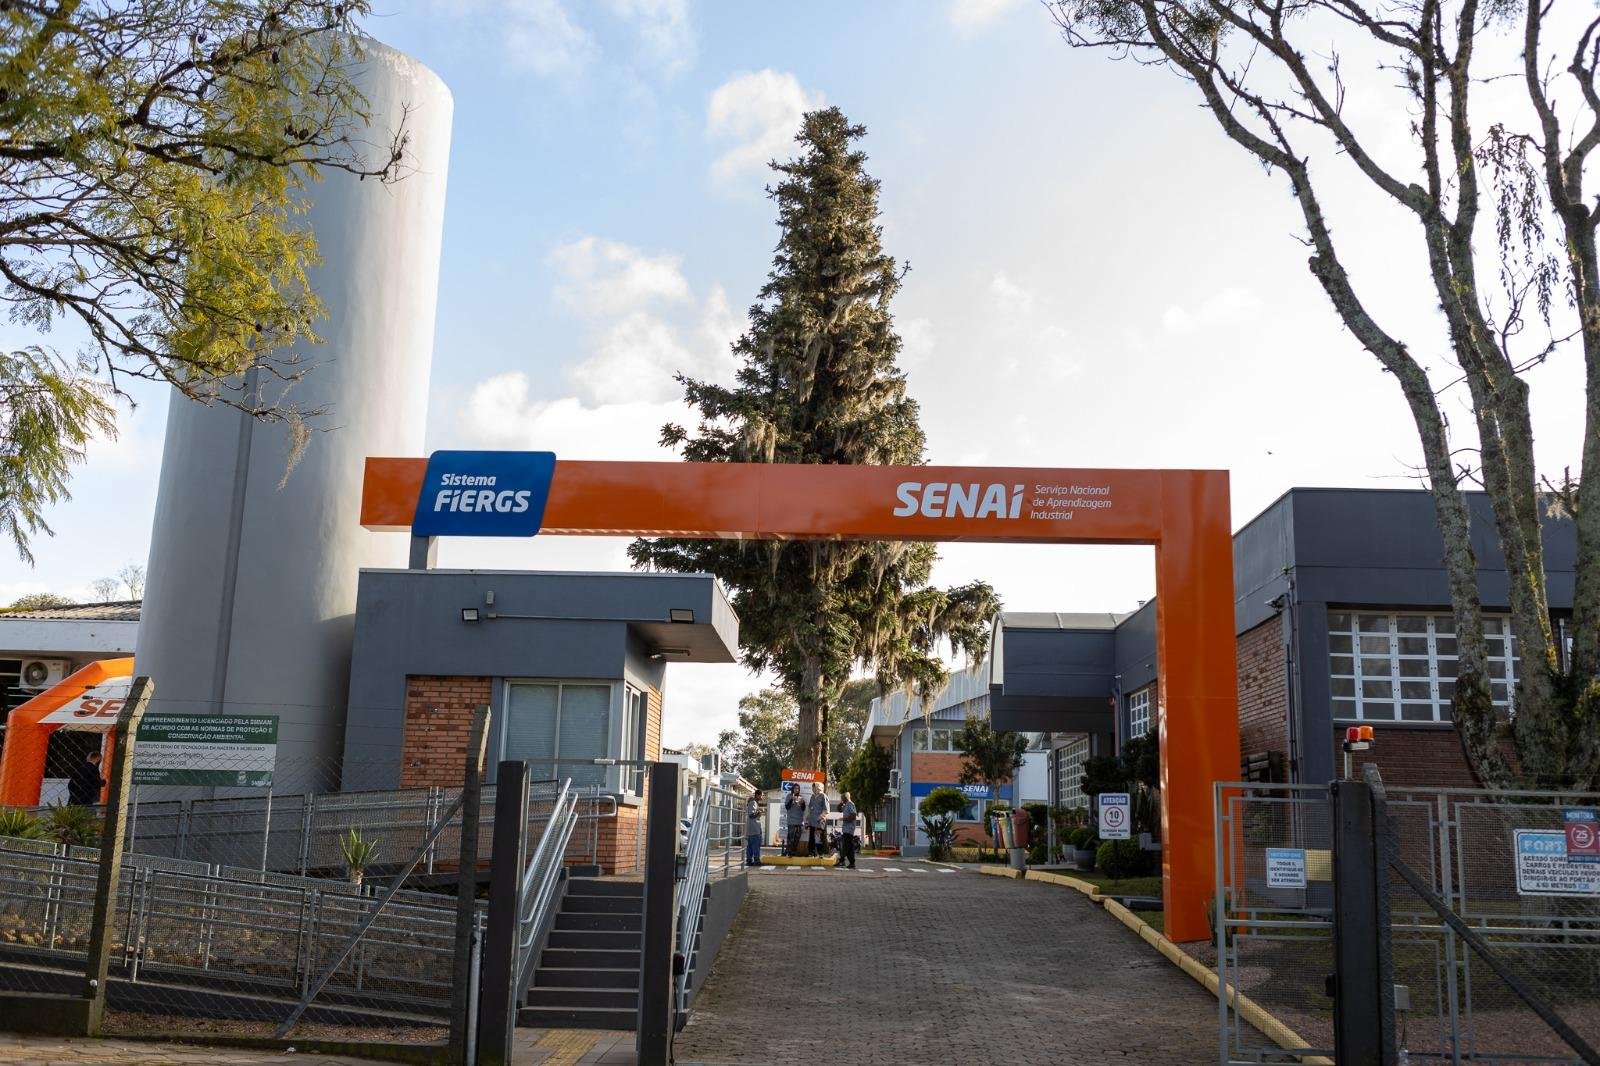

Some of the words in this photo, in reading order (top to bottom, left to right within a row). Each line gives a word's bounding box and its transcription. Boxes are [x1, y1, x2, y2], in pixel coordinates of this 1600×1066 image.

[441, 473, 496, 486] Sistema
[1035, 484, 1068, 496] Serviço
[1069, 485, 1110, 495] Nacional
[1032, 497, 1045, 507] de
[1046, 497, 1112, 510] Aprendizagem
[1030, 510, 1073, 520] Industrial
[73, 699, 126, 718] SE
[792, 771, 815, 780] SENAI
[963, 784, 989, 793] SENAI
[1110, 810, 1120, 819] 10
[1575, 829, 1588, 839] 25
[1524, 840, 1563, 852] PORT
